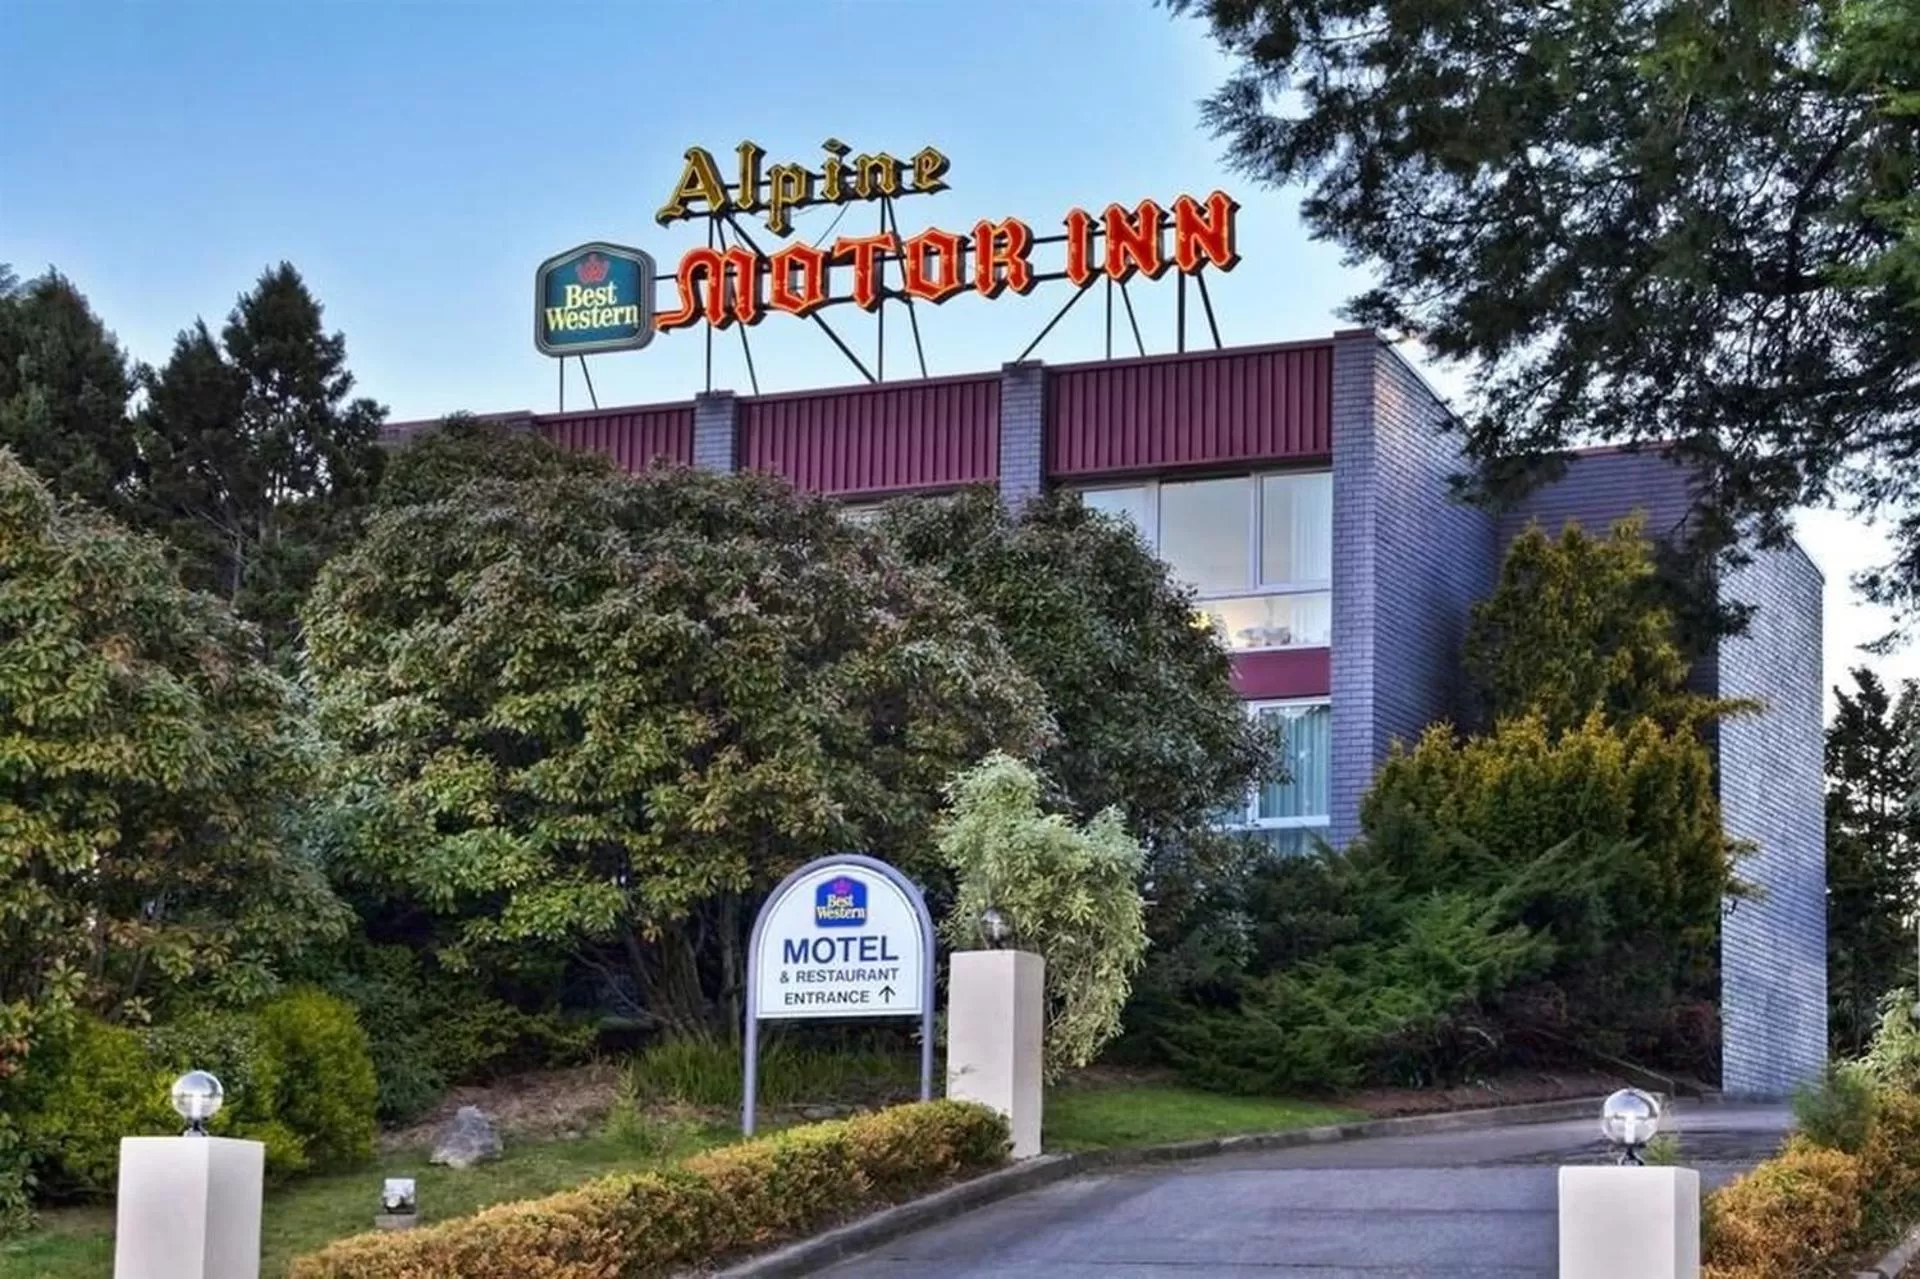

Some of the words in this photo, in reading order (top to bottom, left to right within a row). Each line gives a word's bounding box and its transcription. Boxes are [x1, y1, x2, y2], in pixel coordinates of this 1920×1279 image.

[656, 138, 951, 235] Alpine
[653, 216, 1033, 332] MOTOR
[1066, 189, 1241, 288] INN
[565, 281, 618, 309] Best
[545, 304, 639, 331] Western
[816, 906, 865, 920] Western
[827, 894, 854, 908] Best
[783, 936, 899, 964] MOTEL
[780, 970, 789, 984] &
[796, 967, 900, 984] RESTAURANT
[784, 990, 870, 1005] ENTRANCE
